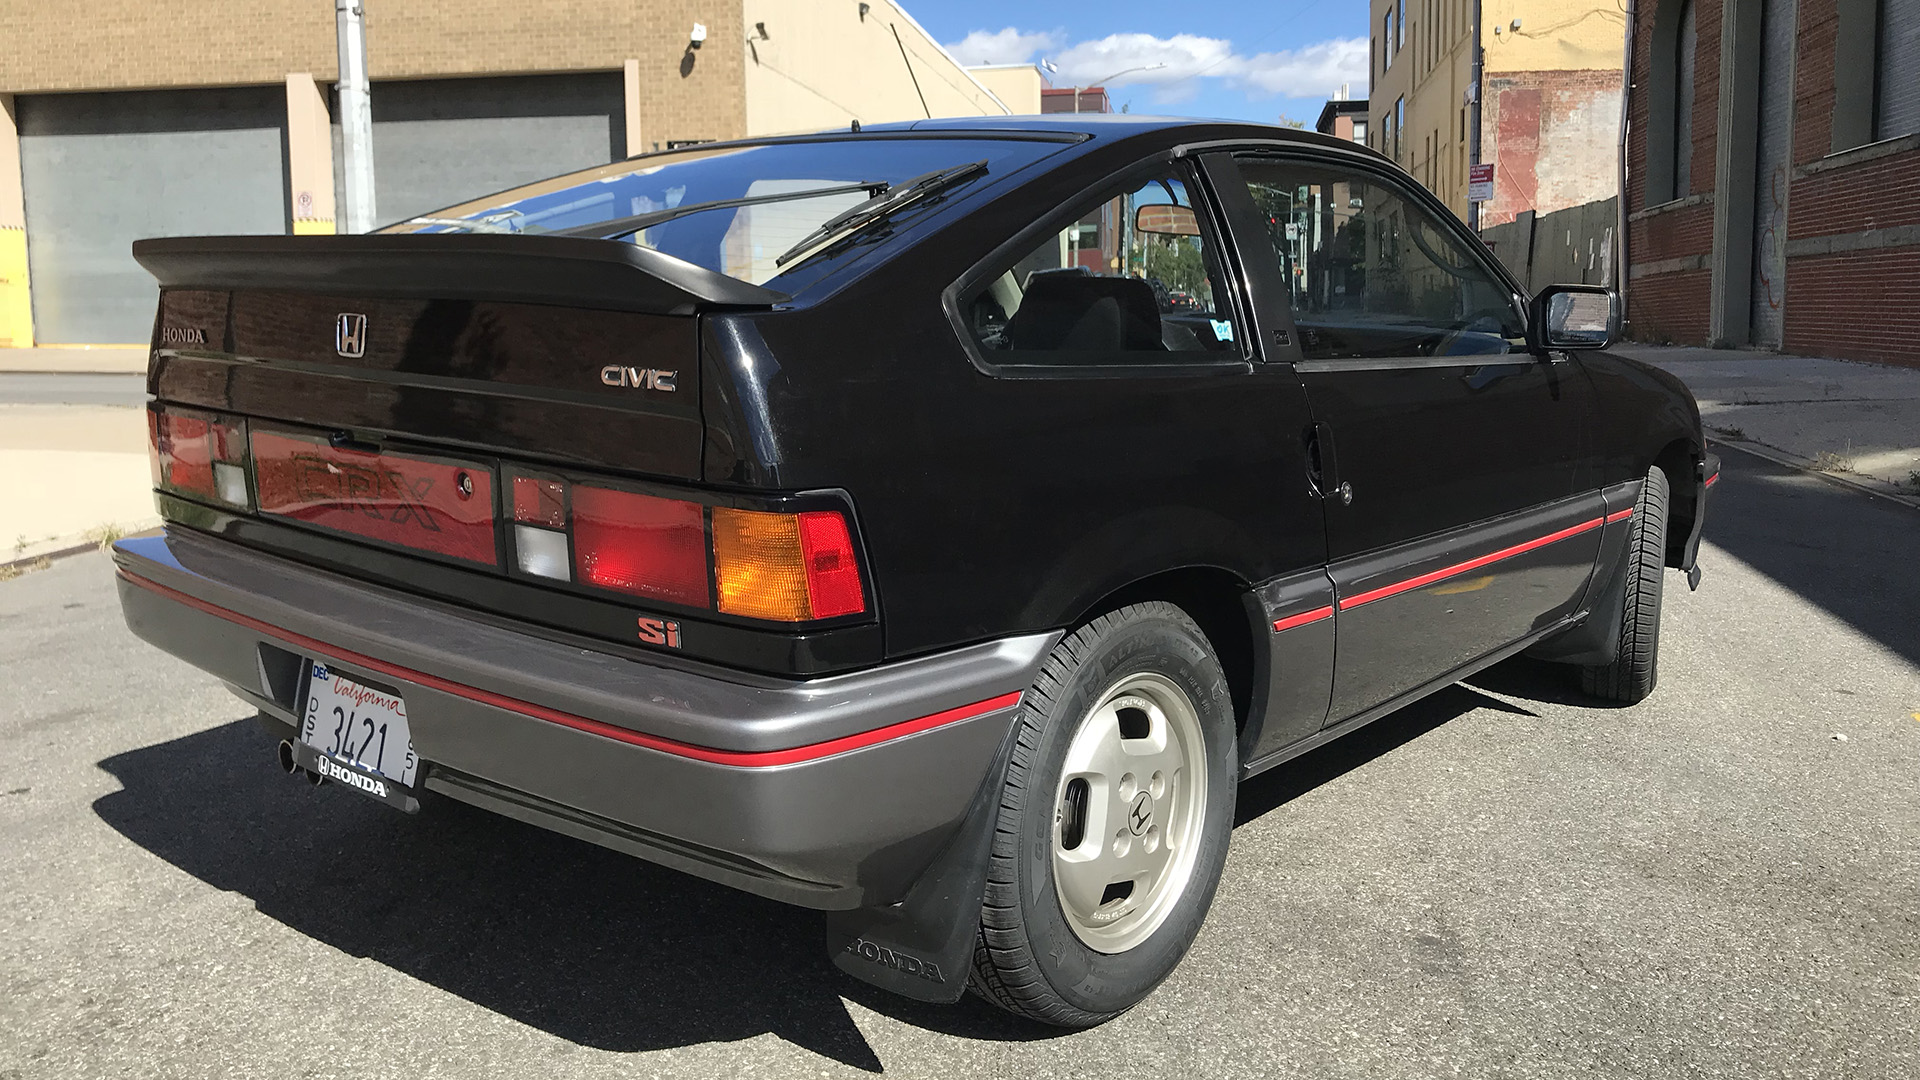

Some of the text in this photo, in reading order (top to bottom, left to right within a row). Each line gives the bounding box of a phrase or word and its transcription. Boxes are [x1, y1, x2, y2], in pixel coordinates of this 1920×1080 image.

[162, 327, 205, 344] HONDA
[1216, 324, 1230, 334] OK
[600, 365, 677, 392] CIVIC
[637, 616, 681, 649] Si
[313, 664, 329, 681] DEC
[333, 676, 406, 717] California
[326, 705, 387, 775] 3421
[328, 762, 387, 798] HONDA
